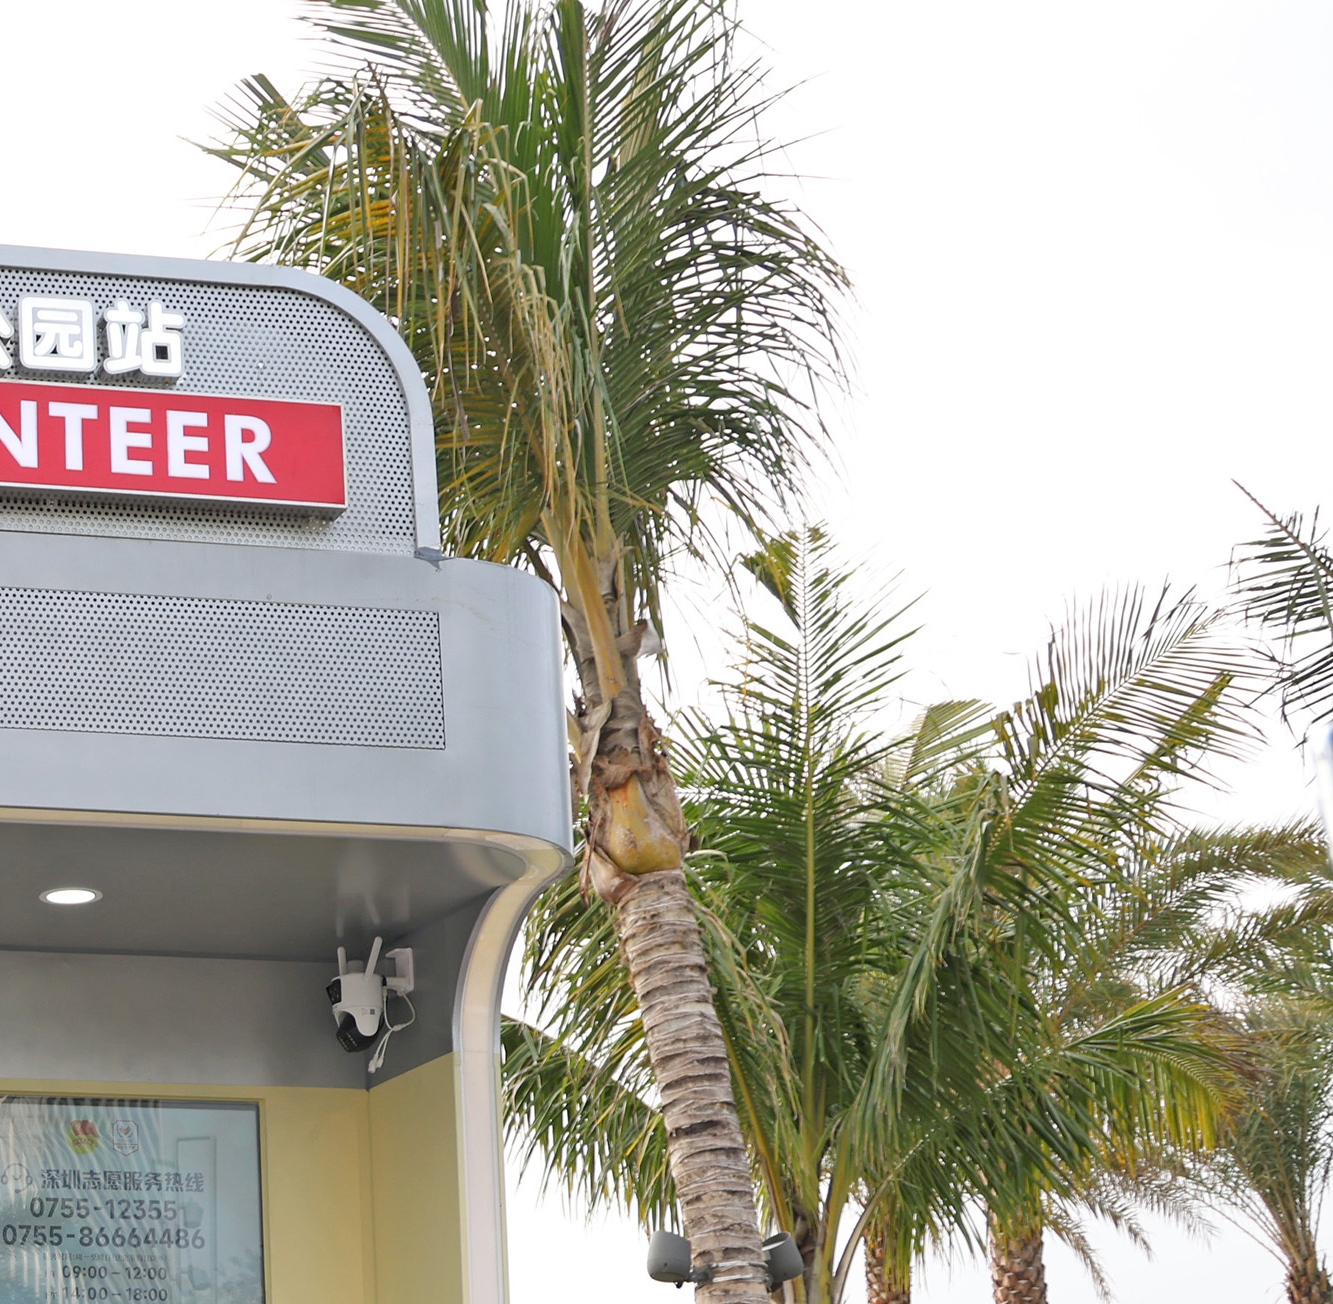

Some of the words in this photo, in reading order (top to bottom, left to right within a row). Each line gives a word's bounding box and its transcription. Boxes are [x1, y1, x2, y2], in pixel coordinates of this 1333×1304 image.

[41, 1168, 205, 1193] 深圳志愿服务热线
[29, 1197, 178, 1221] 0755-12355
[2, 1223, 206, 1249] 0755-86664486
